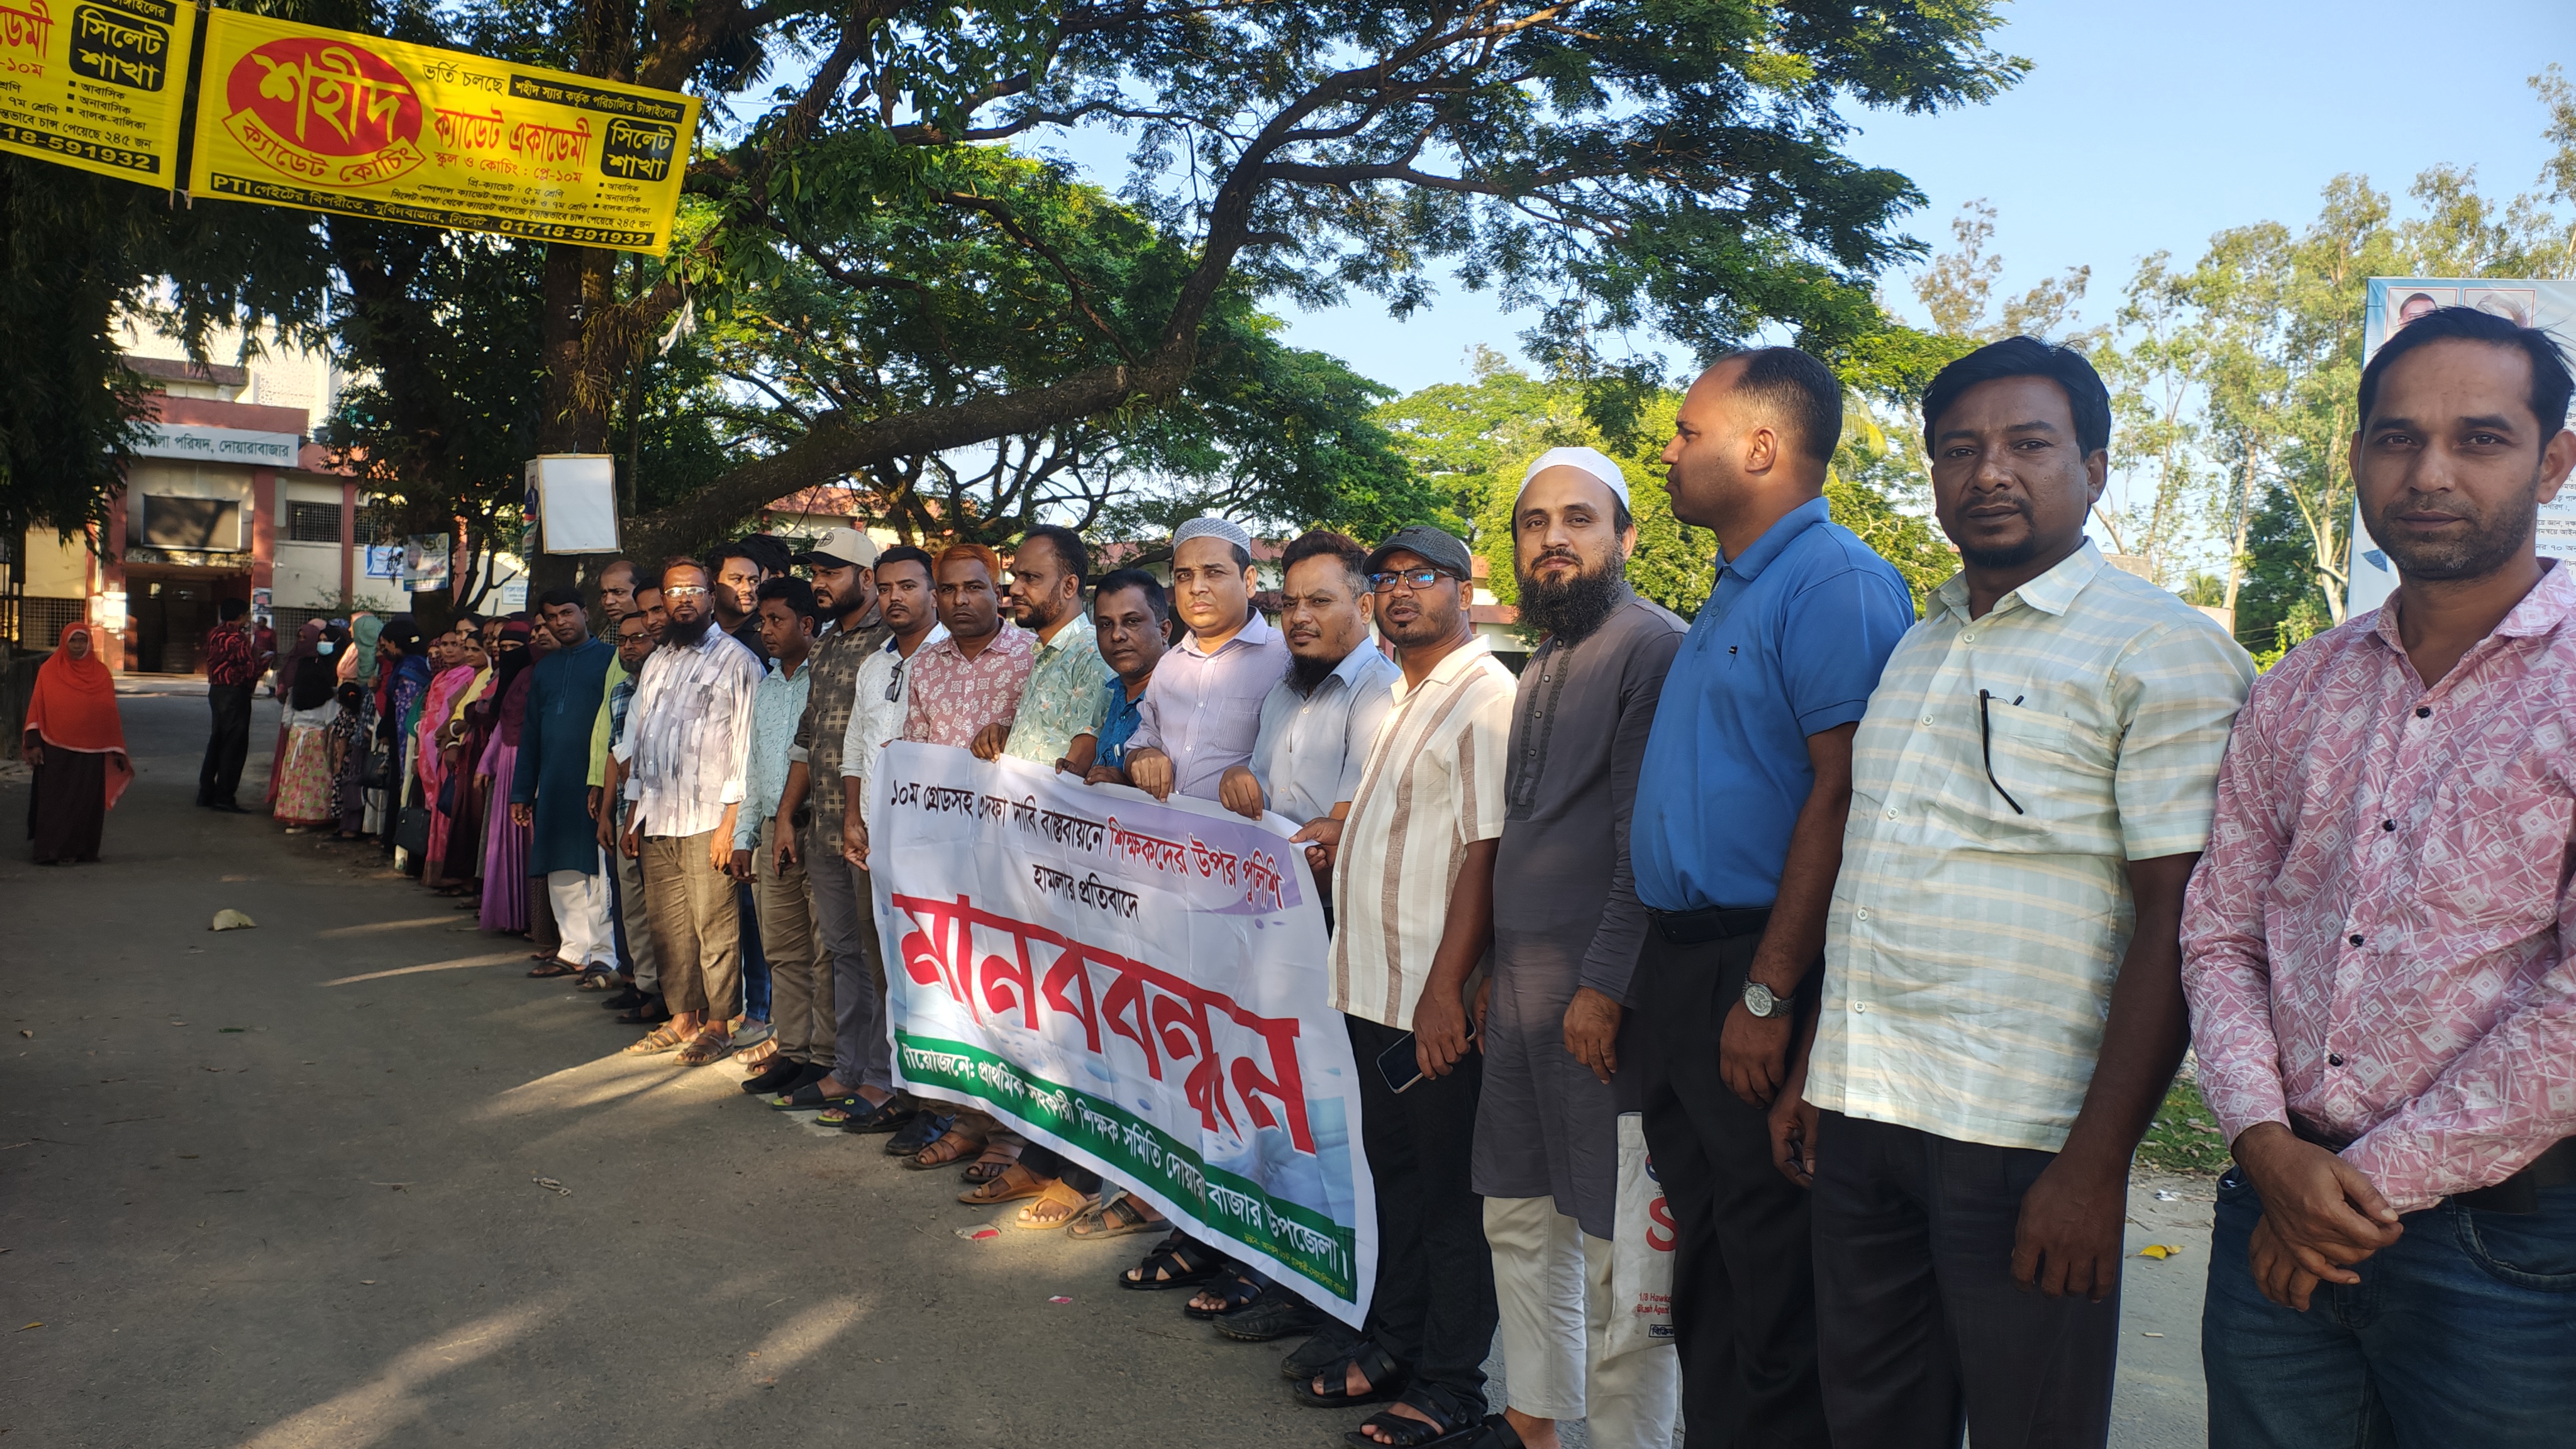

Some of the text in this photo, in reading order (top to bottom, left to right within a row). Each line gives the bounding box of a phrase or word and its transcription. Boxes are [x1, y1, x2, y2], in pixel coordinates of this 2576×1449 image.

[79, 9, 165, 55] সিলেট
[77, 48, 160, 90] শাখা
[422, 61, 506, 97] ভর্তি চলছে
[8, 96, 59, 116] ৭ম শ্রেণি
[79, 96, 132, 115] অনাবাসিক
[80, 82, 126, 100] আবাসিক
[250, 46, 411, 145] শহীদ
[514, 80, 679, 119] শহীদ স্যার কর্তৃক পরিচালিত টাঙ্গাইলের
[38, 117, 60, 131] চান্স
[62, 123, 102, 142] পেয়েছে
[105, 131, 130, 145] ২৪৫
[135, 136, 152, 151] জন
[78, 108, 147, 131] বালক-বালিকা
[433, 103, 592, 169] ক্যাডেট একাডেমী
[610, 119, 675, 152] সিলেট
[242, 117, 420, 182] ক্যাডেট কোচিং
[606, 153, 667, 180] শাখা
[433, 152, 459, 169] স্কুল
[464, 157, 474, 168] ও
[480, 157, 518, 177] কোচিং
[533, 166, 584, 184] প্লে-১০ম
[457, 189, 490, 199] ক্যাডেট
[492, 194, 512, 203] ব্যাচ
[567, 203, 588, 211] শ্রেণি
[467, 177, 514, 192] প্রি-ক্যাডেট
[544, 189, 565, 199] শ্রেণি
[604, 194, 641, 203] অনাবাসিক
[607, 182, 640, 192] আবাসিক
[214, 175, 251, 194] PTI
[253, 185, 304, 203] গেইটের
[309, 191, 368, 213] বিপরীতে,
[374, 203, 445, 224] সুবিদবাজার,
[449, 213, 488, 226] সিলেট
[499, 219, 648, 245] 01718-591932
[391, 188, 419, 201] সিলেট
[420, 195, 441, 205] শাখা
[441, 198, 465, 208] থেকে
[466, 201, 496, 211] ক্যাডেট
[498, 205, 527, 216] কলেজে
[586, 215, 615, 228] পেয়েছে
[616, 218, 636, 228] ২৪৫
[638, 220, 652, 230] জন
[602, 204, 651, 215] বালক-বালিকা
[174, 433, 215, 454] পরিষদ,
[219, 439, 290, 457] দোয়ারাবাজার
[891, 780, 921, 809] ১০ম
[923, 784, 975, 821] গ্রেডসহ
[1011, 794, 1039, 837] দাবি
[1040, 809, 1106, 855] বাস্তবায়নে
[1108, 816, 1190, 878] শিক্ষকদের
[1189, 834, 1238, 891] উপর
[1242, 849, 1285, 911] পুলিশি
[1032, 863, 1140, 924] হামলার প্রতিবাদে
[892, 893, 1316, 1156] মানববন্ধন
[978, 1060, 1025, 1101] প্রাথমিক
[1024, 1081, 1075, 1126] সহকারী
[1074, 1097, 1119, 1147] শিক্ষক
[1121, 1122, 1163, 1169] সমিতি
[1263, 1195, 1339, 1274] উপজেলা
